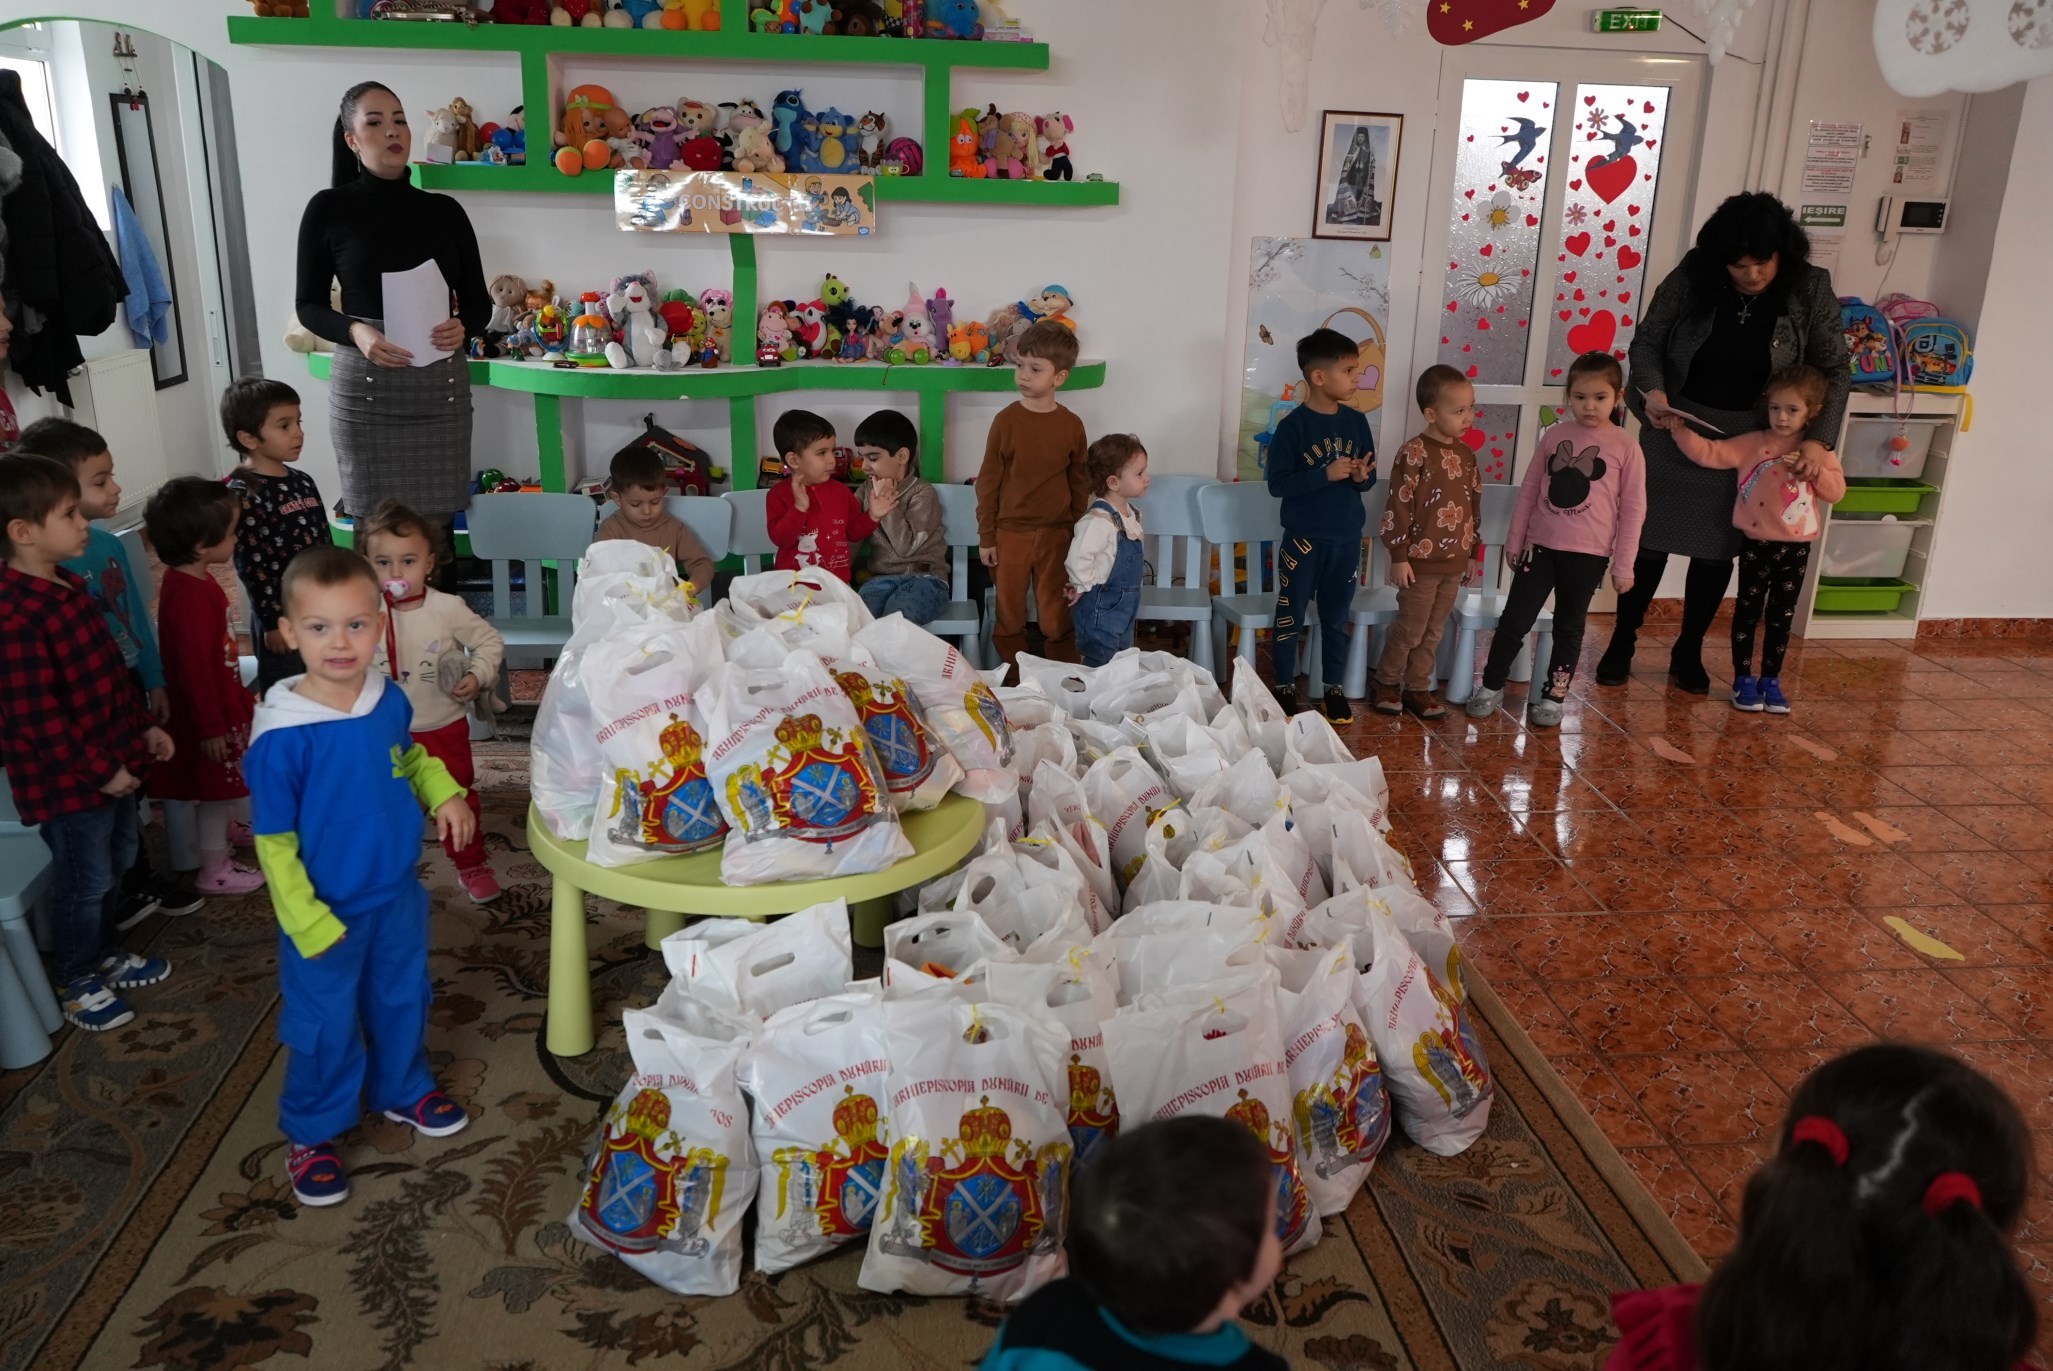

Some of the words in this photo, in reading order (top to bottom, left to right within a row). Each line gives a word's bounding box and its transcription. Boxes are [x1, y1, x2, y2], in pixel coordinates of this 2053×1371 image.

[1609, 13, 1649, 30] EXIT
[1802, 206, 1846, 216] IEȘIRE
[1035, 1090, 1049, 1104] DE
